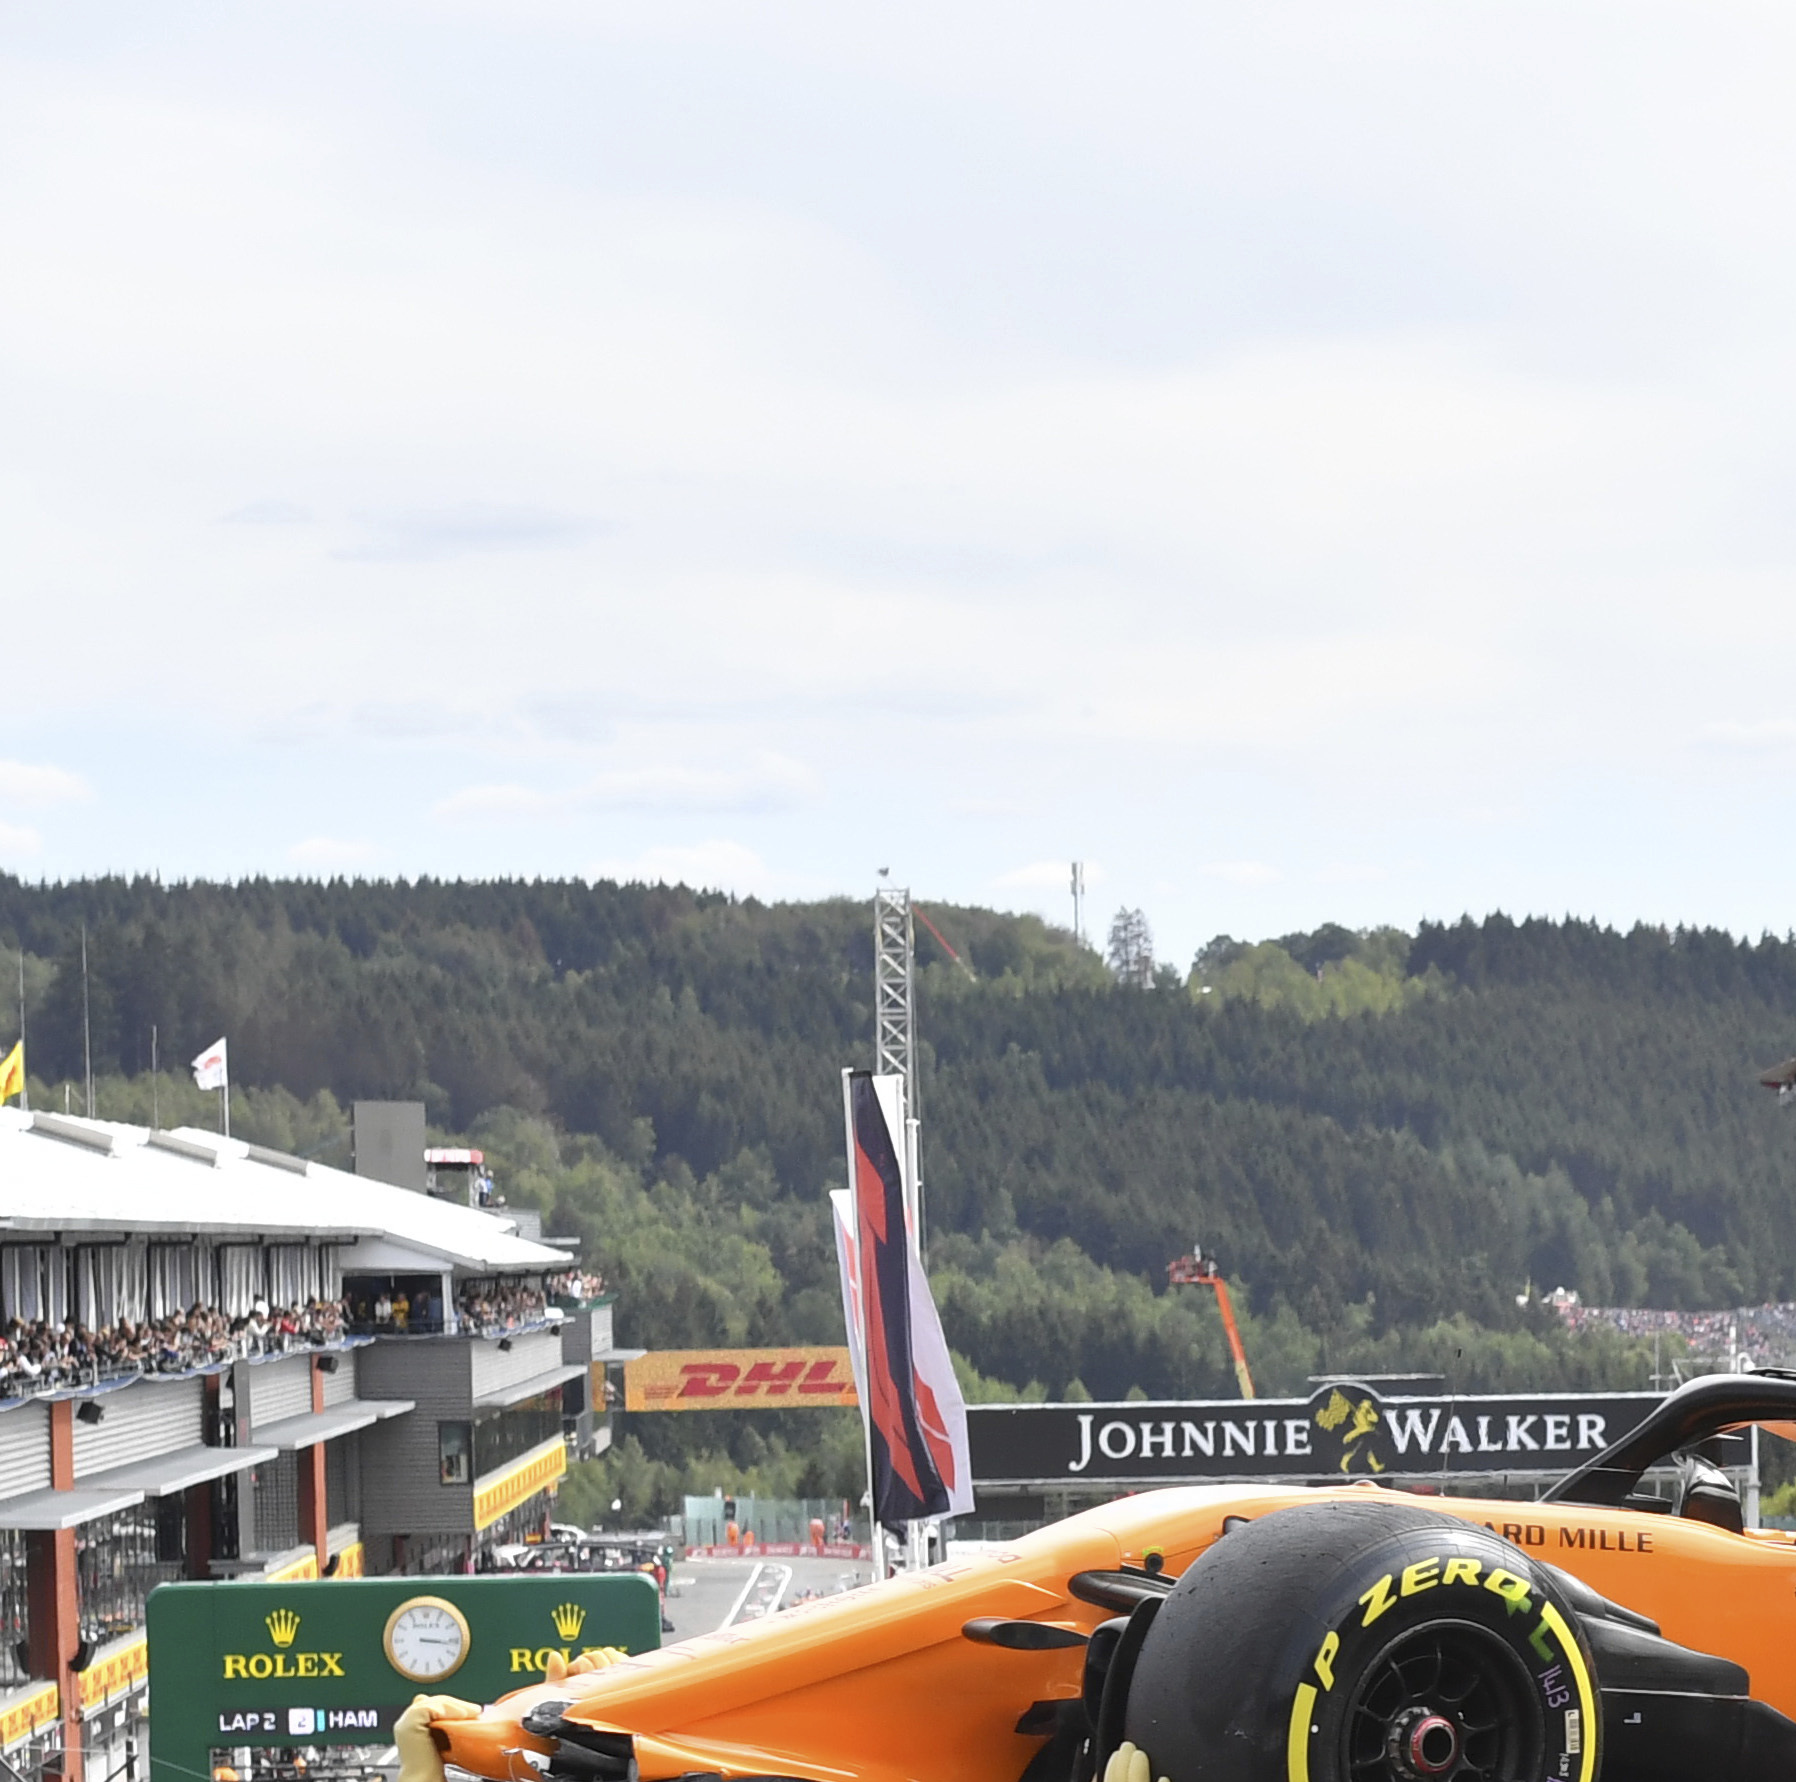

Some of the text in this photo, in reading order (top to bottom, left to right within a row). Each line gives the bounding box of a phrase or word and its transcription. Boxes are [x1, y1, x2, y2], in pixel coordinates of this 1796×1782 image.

[676, 1361, 854, 1398] DHL
[1068, 1406, 1607, 1473] JOHNNIE WALKER
[1558, 1527, 1655, 1554] MILLE
[1313, 1556, 1531, 1692] P ZERO
[223, 1652, 345, 1679] ROLEX
[219, 1713, 260, 1732] LAP
[328, 1709, 379, 1729] HAM
